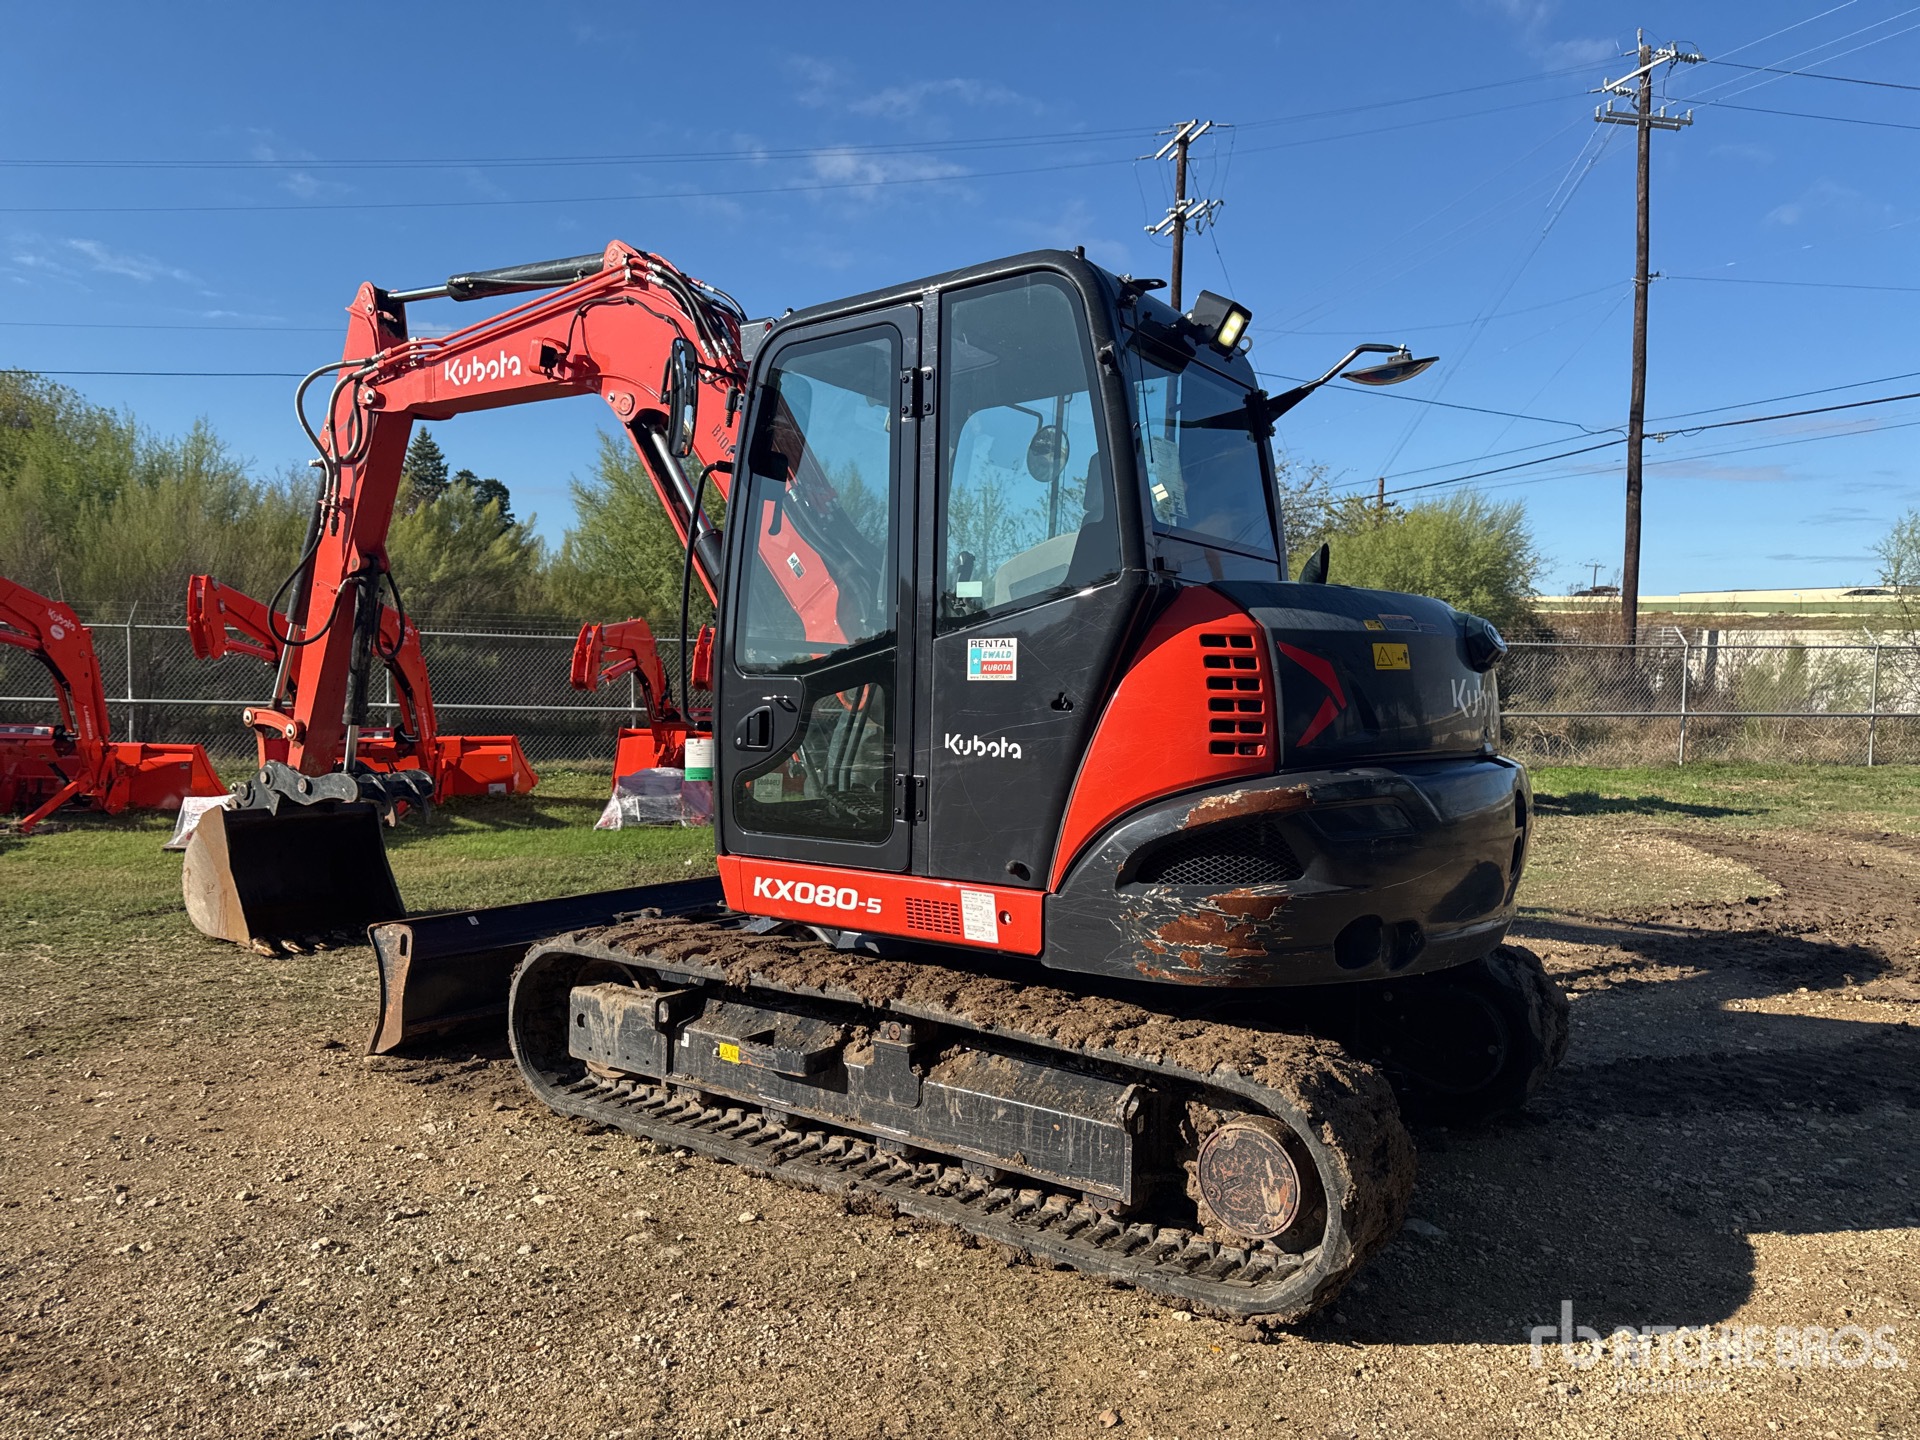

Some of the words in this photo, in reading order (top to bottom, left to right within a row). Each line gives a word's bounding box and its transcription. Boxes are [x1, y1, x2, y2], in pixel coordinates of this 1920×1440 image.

[444, 350, 521, 386] Kubota
[970, 639, 1013, 648] RENTAL
[982, 651, 1012, 659] EWALD
[982, 663, 1011, 671] KUBOTA
[944, 733, 1022, 760] Kubota
[753, 876, 882, 914] KX080-5
